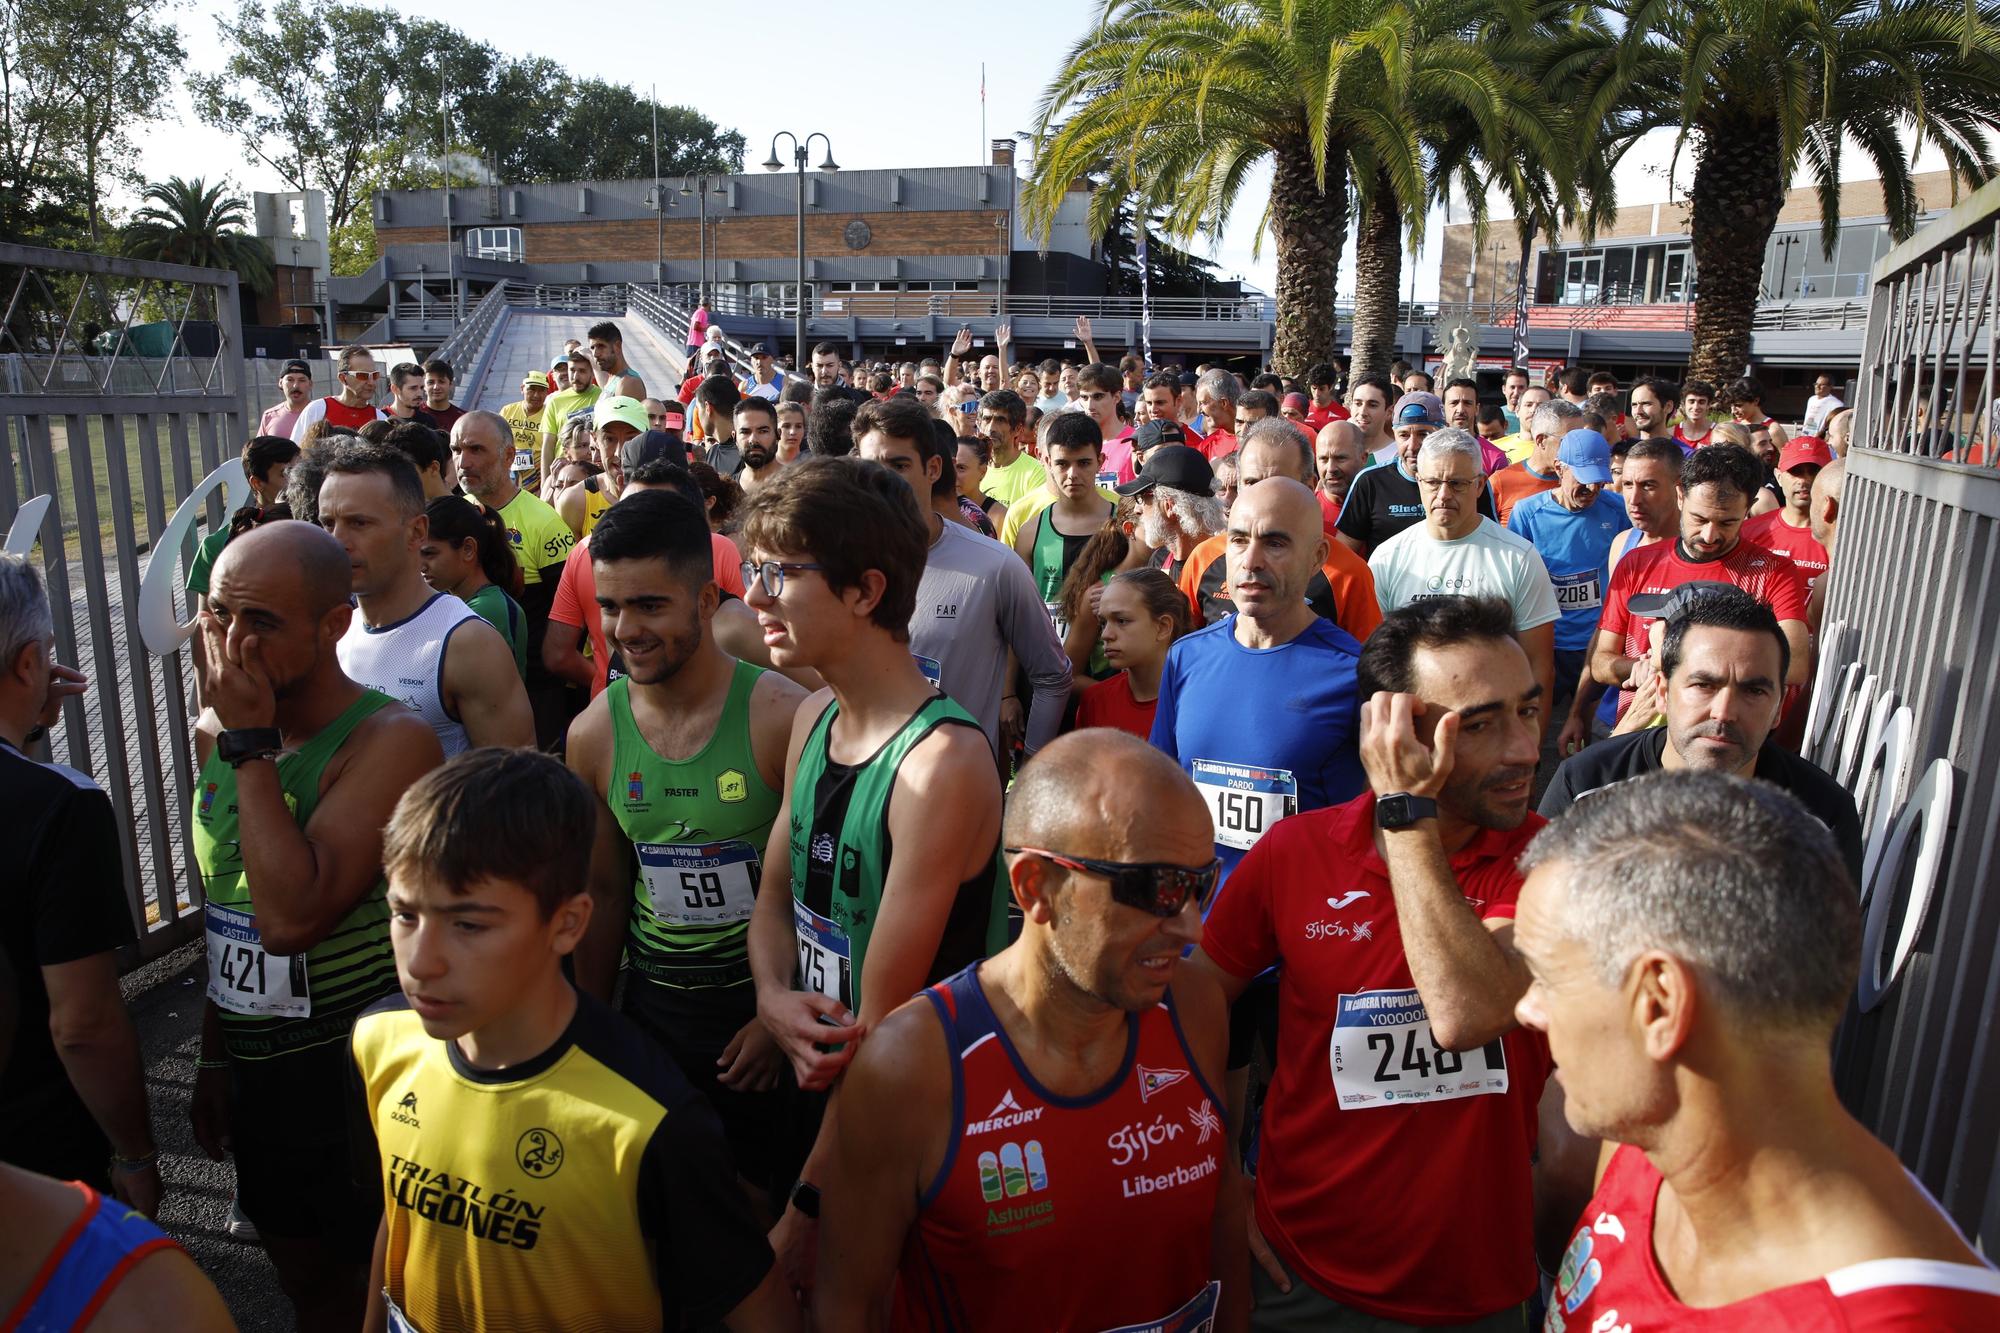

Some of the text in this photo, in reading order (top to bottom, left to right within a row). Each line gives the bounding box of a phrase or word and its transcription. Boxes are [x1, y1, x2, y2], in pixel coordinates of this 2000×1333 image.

[1388, 504, 1418, 513] Blue
[1557, 584, 1589, 603] 208
[936, 604, 957, 615] FAR
[398, 677, 424, 686] VESKIN
[664, 788, 699, 797] FASTER
[1227, 779, 1254, 791] PARDO
[1217, 791, 1263, 834] 150
[679, 872, 726, 908] 59
[1305, 920, 1350, 940] gijón
[220, 943, 266, 995] 421
[1380, 993, 1421, 1009] POPULAR
[1367, 1028, 1463, 1082] 248
[965, 1106, 1045, 1136] MERCURY
[1107, 1114, 1184, 1166] gijón
[390, 1153, 547, 1220] TRIATLÓN
[1121, 1154, 1217, 1198] Liberbank
[986, 1198, 1055, 1226] Asturias
